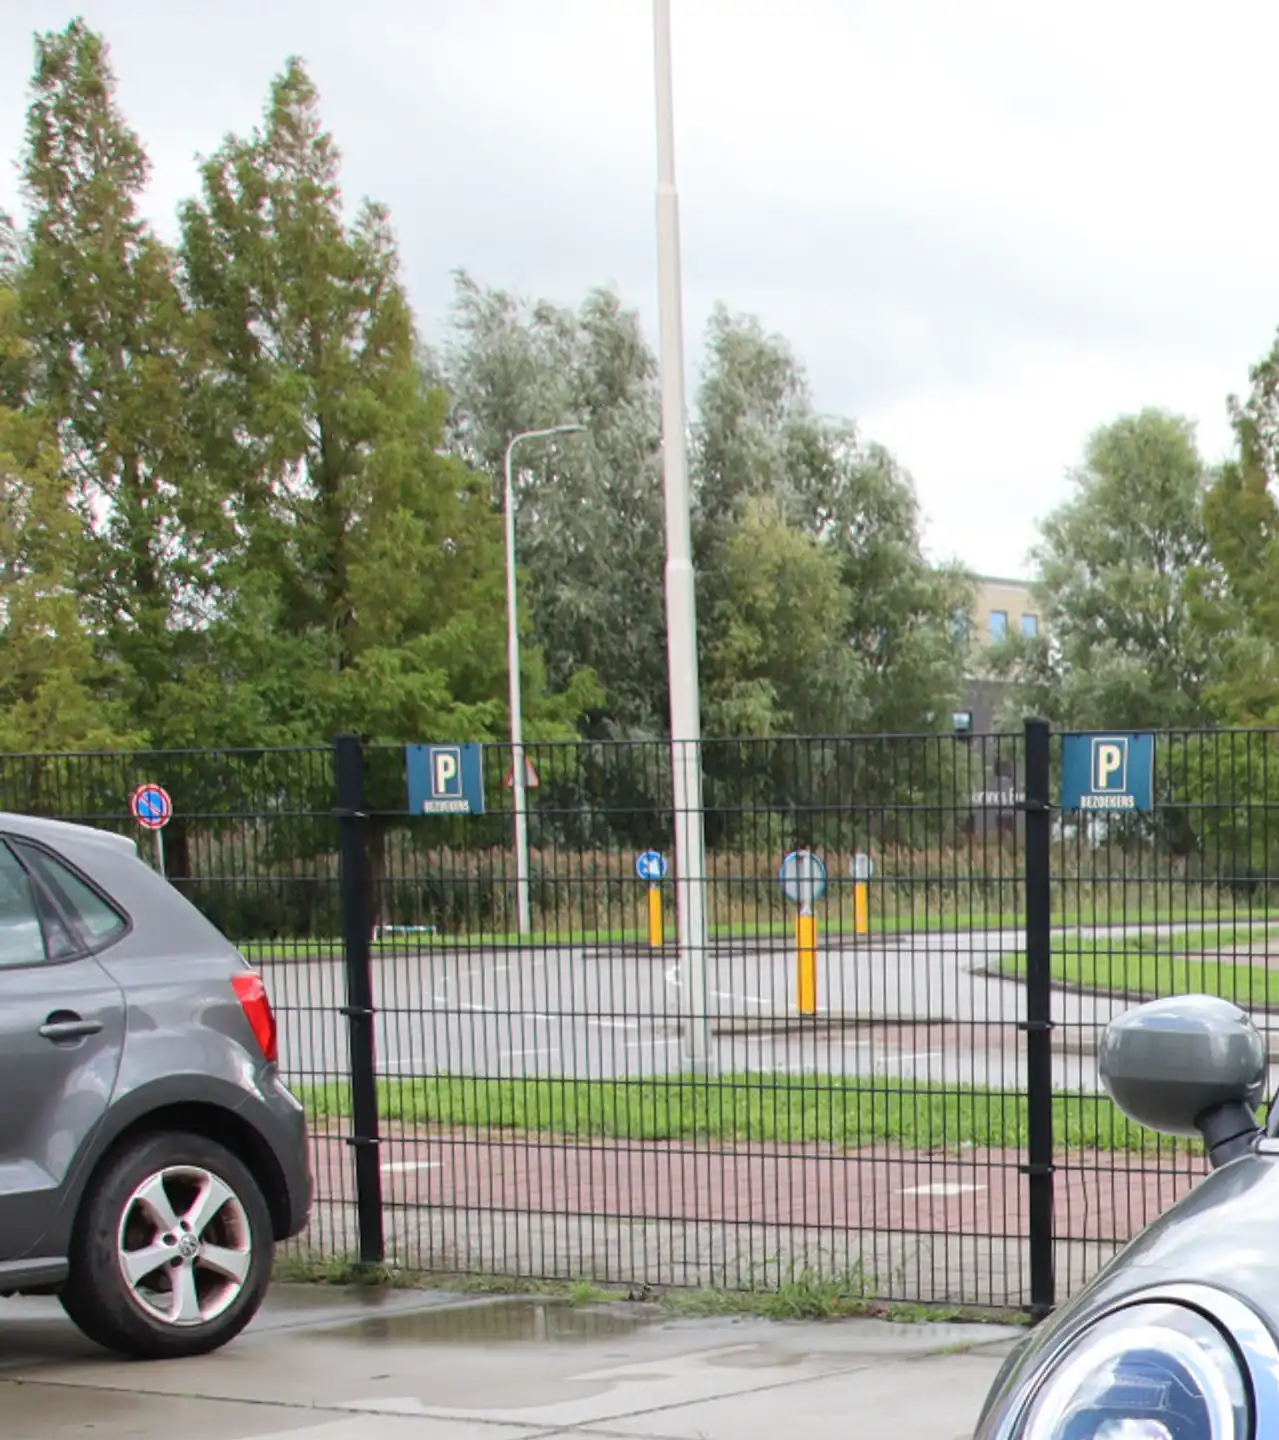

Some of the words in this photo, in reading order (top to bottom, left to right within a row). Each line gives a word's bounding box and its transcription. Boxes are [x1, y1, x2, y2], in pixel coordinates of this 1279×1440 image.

[436, 753, 456, 793] P
[1098, 744, 1121, 788] P
[1080, 795, 1135, 808] BEZOEKERS
